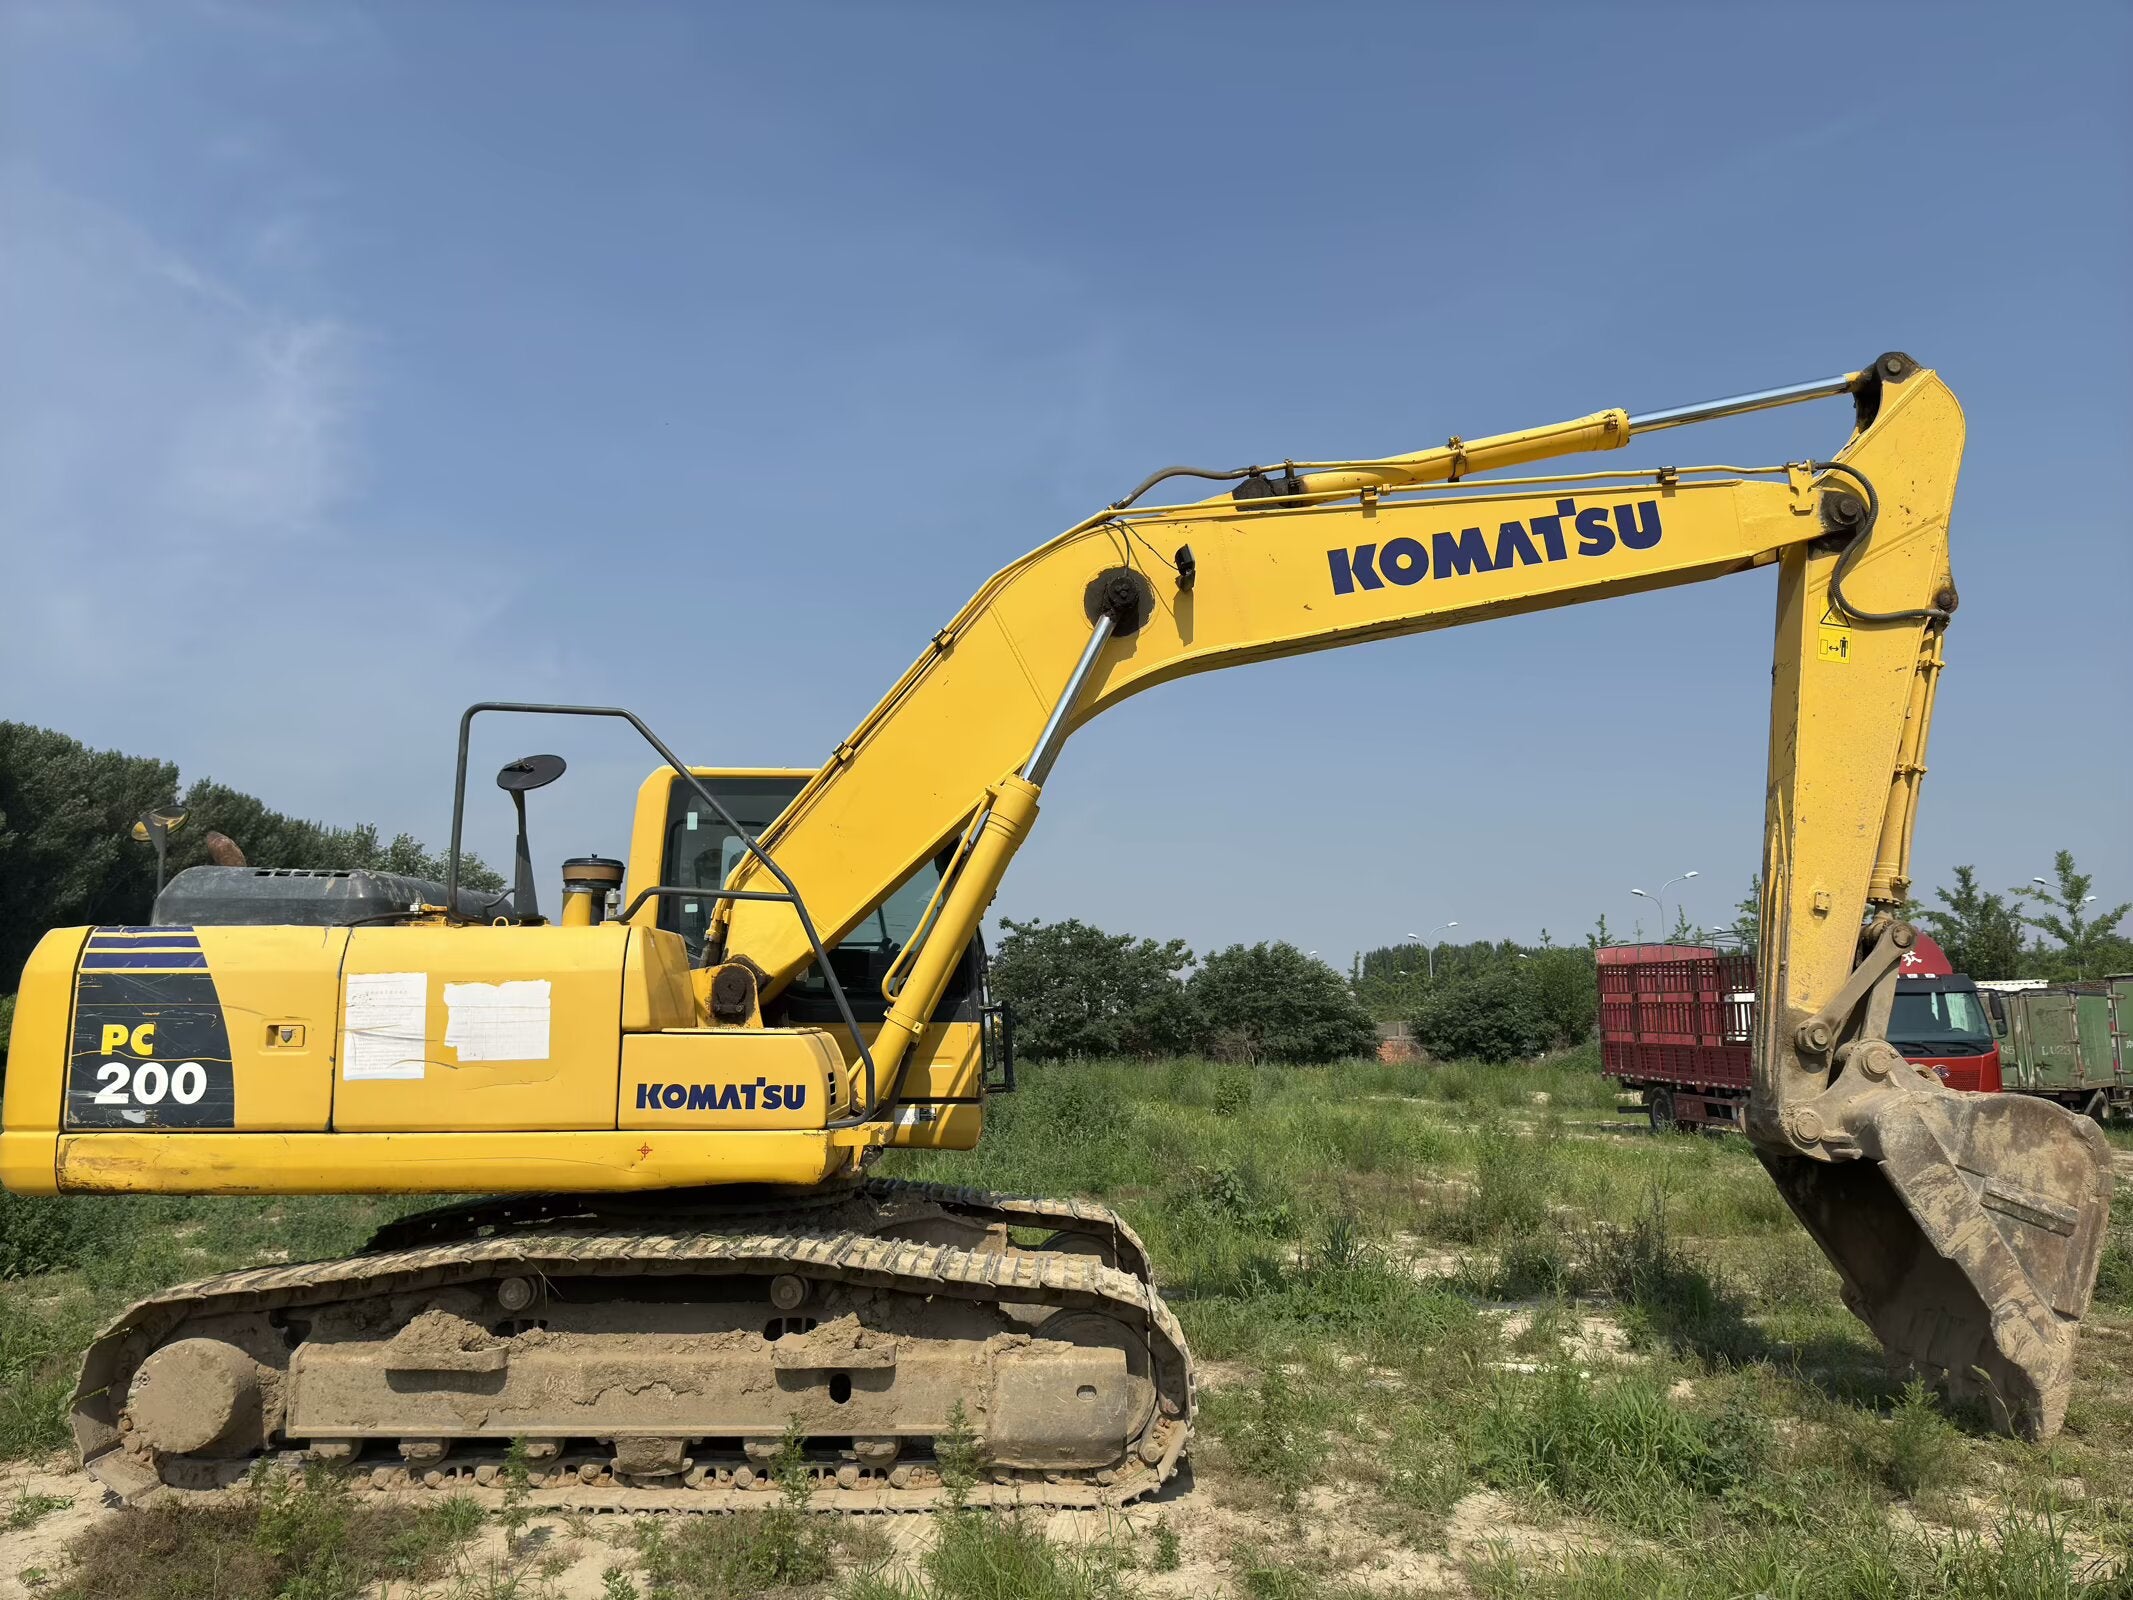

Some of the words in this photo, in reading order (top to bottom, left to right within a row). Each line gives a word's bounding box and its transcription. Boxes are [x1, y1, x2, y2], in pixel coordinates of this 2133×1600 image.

[1327, 498, 1663, 595] KOMATSU
[101, 1023, 156, 1056] PC
[94, 1061, 208, 1105] 200
[636, 1077, 806, 1110] KOMATSU
